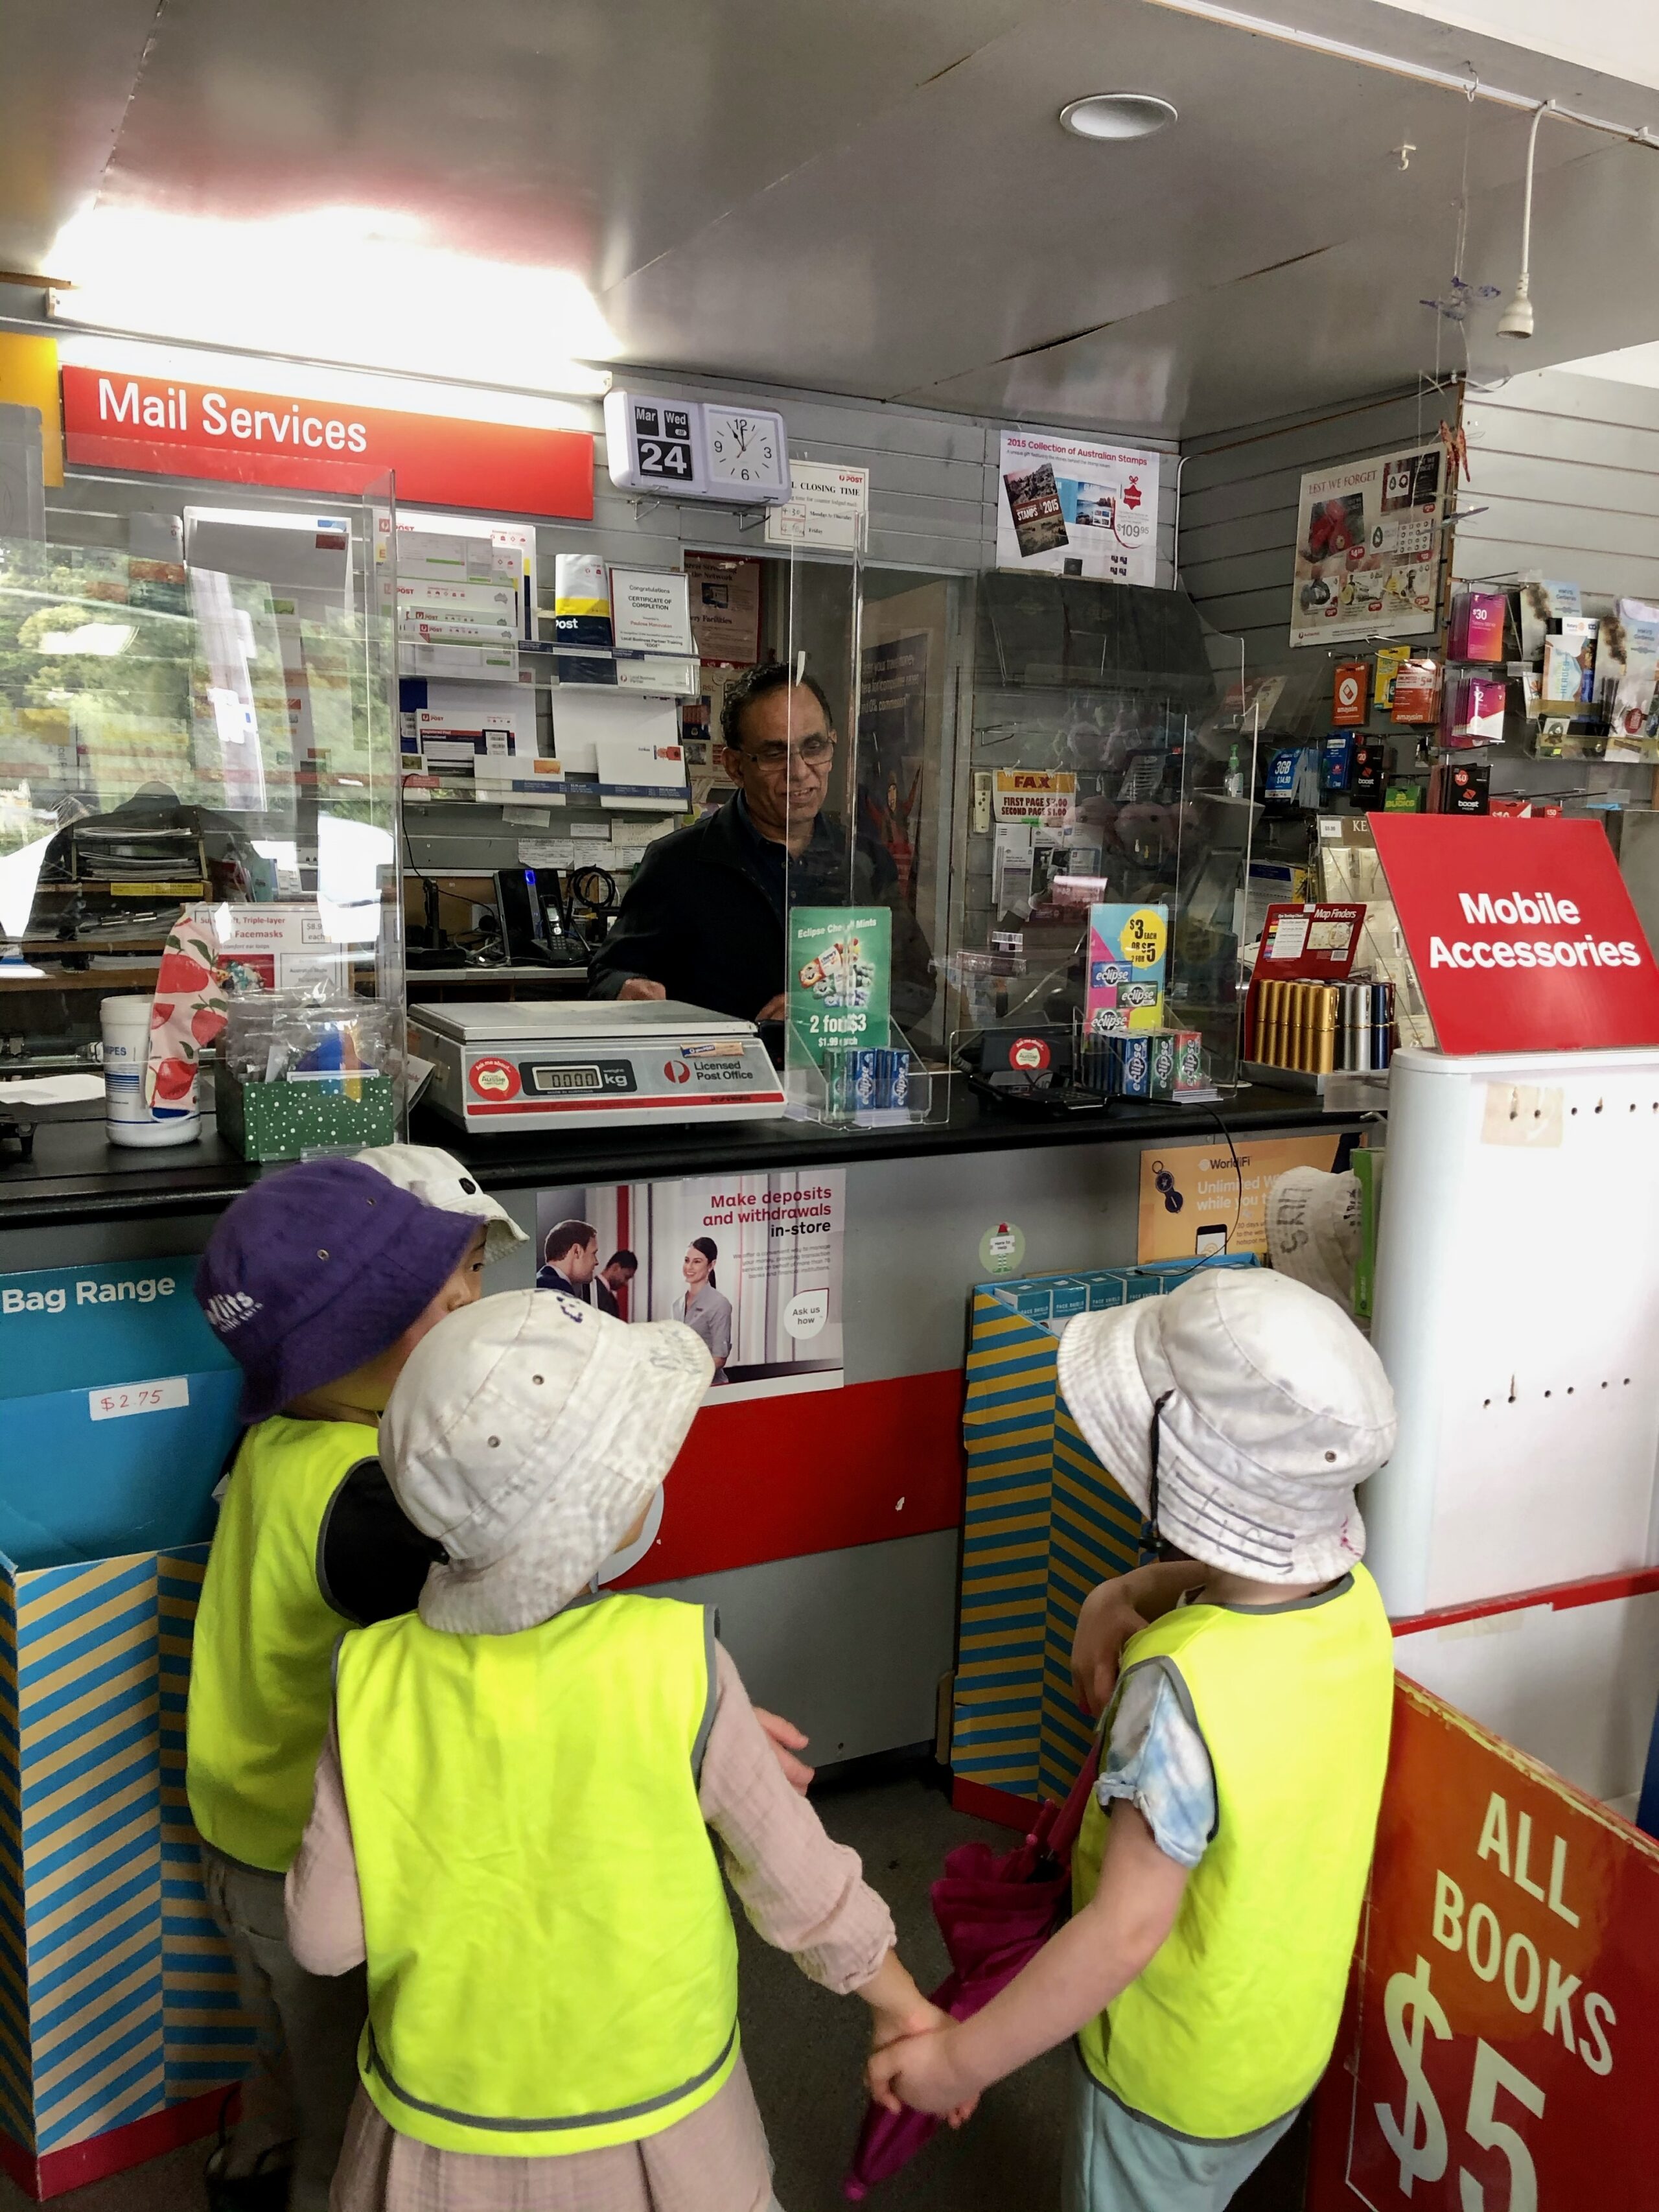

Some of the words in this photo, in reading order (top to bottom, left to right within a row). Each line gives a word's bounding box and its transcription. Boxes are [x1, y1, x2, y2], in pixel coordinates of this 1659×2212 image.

[99, 378, 187, 432] Mail
[202, 392, 368, 454] Services
[636, 408, 656, 421] Mar
[665, 412, 686, 425] Wed
[734, 419, 747, 431] 12
[714, 441, 723, 452] 9
[763, 447, 772, 459] 3
[1007, 438, 1027, 448] 2015
[1028, 441, 1067, 454] Collection
[1077, 448, 1117, 461] Australian
[1118, 455, 1147, 466] Stamps
[640, 442, 687, 474] 24
[741, 469, 750, 480] 6
[1309, 481, 1327, 495] LEST
[1328, 478, 1341, 489] WE
[1343, 470, 1378, 485] FORGET
[800, 482, 835, 493] CLOSING
[840, 487, 860, 496] TIME
[1017, 507, 1038, 520] STAMPS
[1043, 498, 1059, 513] 2015
[629, 585, 670, 594] Congratulations
[702, 615, 732, 624] Facilities
[1472, 609, 1487, 620] $30
[1275, 761, 1292, 774] 3GB
[1015, 776, 1050, 788] FAX
[1001, 806, 1027, 815] SECOND
[1028, 807, 1045, 816] PAGE
[1004, 797, 1024, 806] FIRST
[1025, 797, 1044, 807] PAGE
[1314, 909, 1330, 920] Map
[1330, 909, 1357, 918] Finders
[1458, 891, 1581, 925] Mobile
[235, 930, 283, 938] Facemasks
[798, 927, 826, 938] Eclipse
[856, 918, 877, 929] Mints
[1130, 919, 1144, 940] $3
[1141, 942, 1155, 962] $5
[1430, 935, 1641, 968] Accessories
[1096, 969, 1128, 984] eclipse
[1121, 989, 1154, 1004] eclipse
[810, 1015, 819, 1033] 2
[847, 1014, 867, 1034] $3
[1091, 1016, 1128, 1029] eclipse
[694, 1061, 741, 1071] Licensed
[1129, 1043, 1143, 1091] eclipse
[1157, 1040, 1170, 1089] eclipse
[1183, 1038, 1196, 1088] eclipse
[604, 1073, 628, 1087] kg
[696, 1071, 721, 1080] Post
[723, 1071, 753, 1080] Office
[860, 1066, 872, 1105] eclipse
[896, 1067, 907, 1106] eclipse
[711, 1193, 756, 1208] Make
[761, 1186, 832, 1208] deposits
[1197, 1196, 1231, 1211] while
[1235, 1195, 1258, 1211] you
[703, 1208, 734, 1227] and
[738, 1204, 831, 1224] withdrawals
[771, 1219, 831, 1238] in-store
[2, 1287, 66, 1313] Bag
[76, 1277, 176, 1305] Range
[793, 1308, 808, 1316] Ask
[1478, 1791, 1580, 1929] ALL
[1432, 1868, 1618, 2076] BOOKS
[1373, 1953, 1547, 2212] $5
